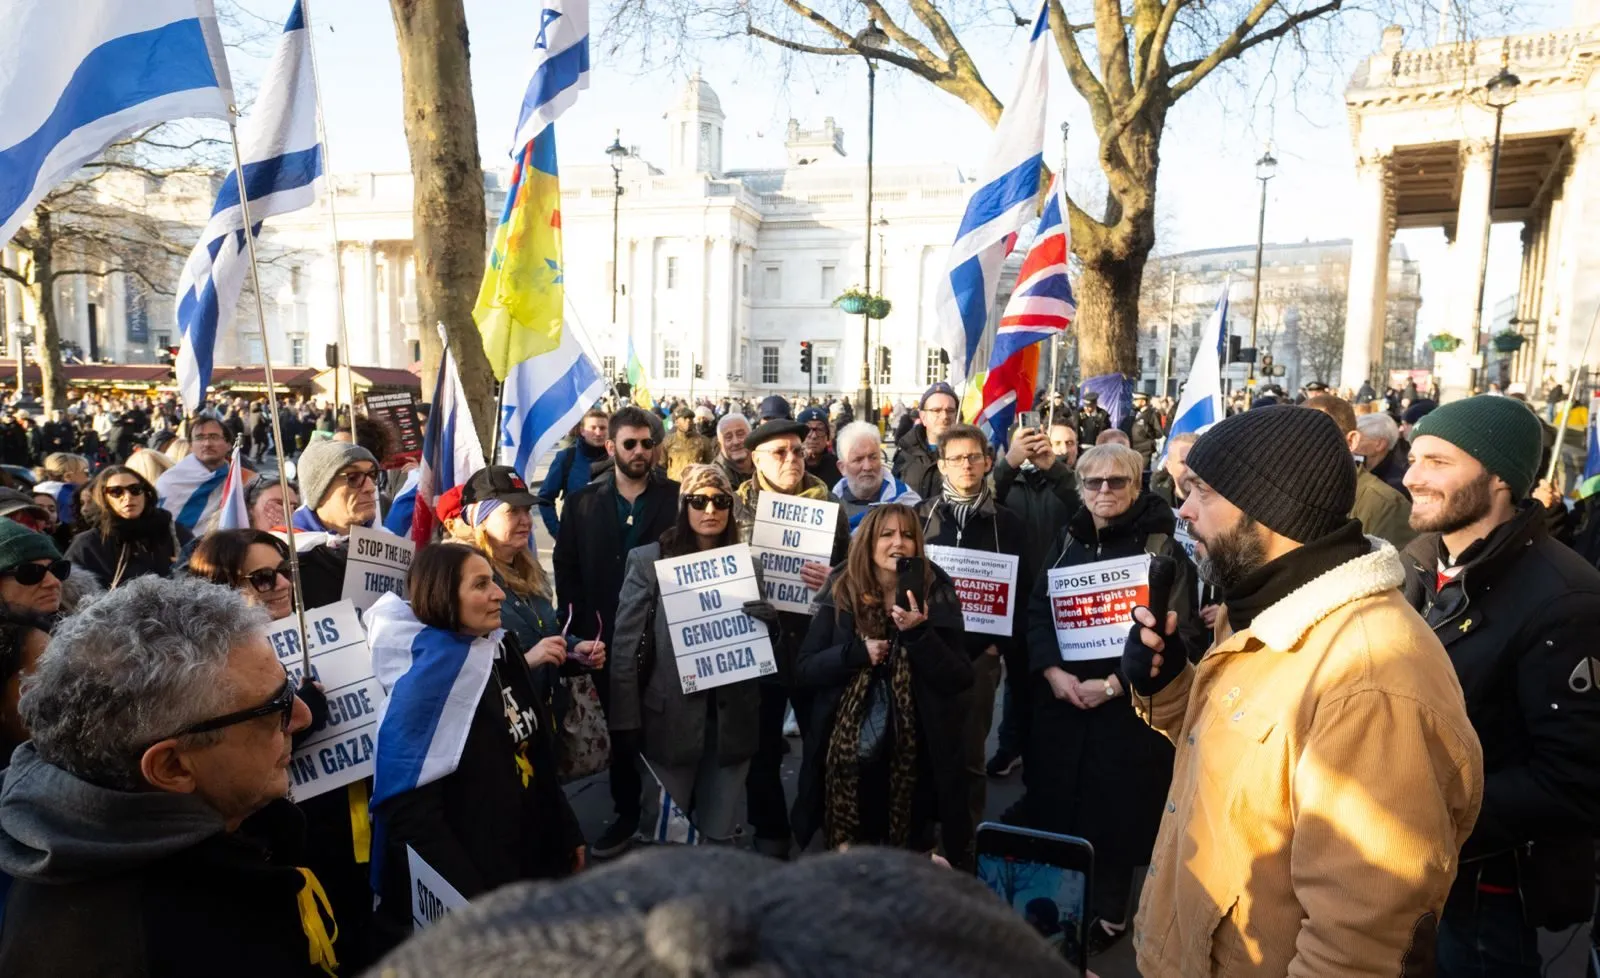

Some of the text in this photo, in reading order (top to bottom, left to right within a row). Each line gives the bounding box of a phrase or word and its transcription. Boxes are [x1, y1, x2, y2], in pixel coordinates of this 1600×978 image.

[771, 501, 824, 525] THERE IS
[782, 529, 801, 548] NO
[357, 538, 411, 566] STOP THE LIES
[760, 551, 821, 575] GENOCI
[673, 555, 738, 586] THERE IS
[957, 566, 993, 577] solidarity!
[981, 560, 1008, 570] unions!
[364, 572, 404, 597] THERE IS
[954, 579, 1001, 592] AGAINST
[1054, 569, 1131, 590] OPPOSE BDS
[698, 589, 722, 612] NO
[778, 583, 808, 604] GAZA
[955, 590, 1005, 604] TRED IS A
[1096, 591, 1123, 603] right
[1125, 589, 1137, 597] to
[961, 602, 993, 613] ISSUE
[1084, 602, 1111, 615] itself
[1114, 603, 1127, 611] as
[314, 617, 340, 645] IS
[682, 614, 757, 648] GENOCIDE
[966, 615, 996, 625] League
[695, 647, 757, 678] IN GAZA
[290, 733, 375, 787] IN GAZA
[417, 878, 444, 923] STOP
